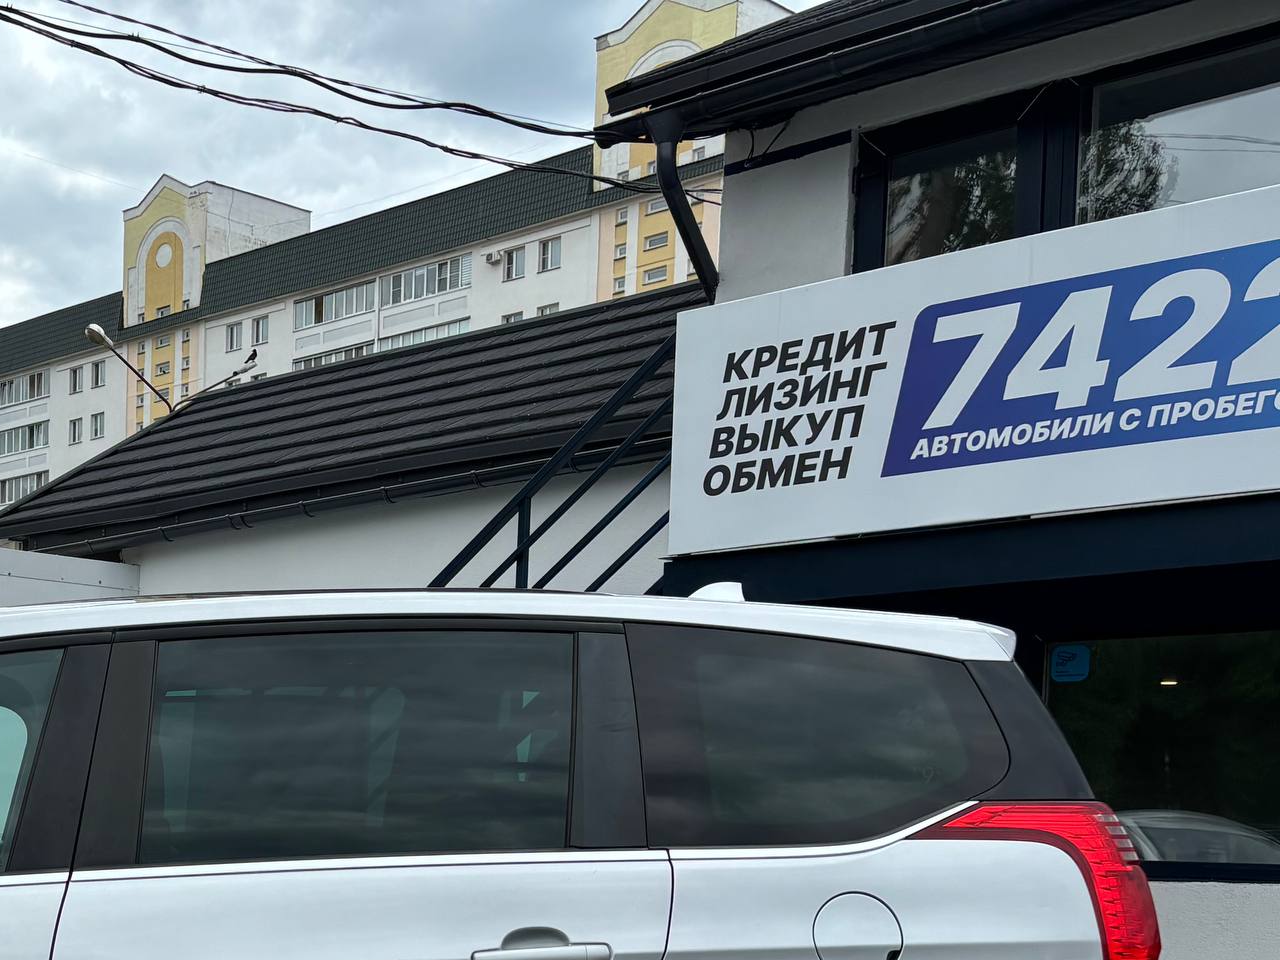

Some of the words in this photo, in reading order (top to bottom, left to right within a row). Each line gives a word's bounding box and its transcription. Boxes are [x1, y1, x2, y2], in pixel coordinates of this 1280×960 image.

[723, 320, 897, 383] КРЕДИТ
[716, 361, 888, 421] ЛИЗИНГ
[709, 404, 865, 459] ВЫКУП
[910, 411, 1115, 460] АВТОМОБИЛИ
[1119, 408, 1142, 431] С
[1147, 389, 1280, 428] ПРОБЕГ
[703, 446, 853, 496] ОБМЕН
